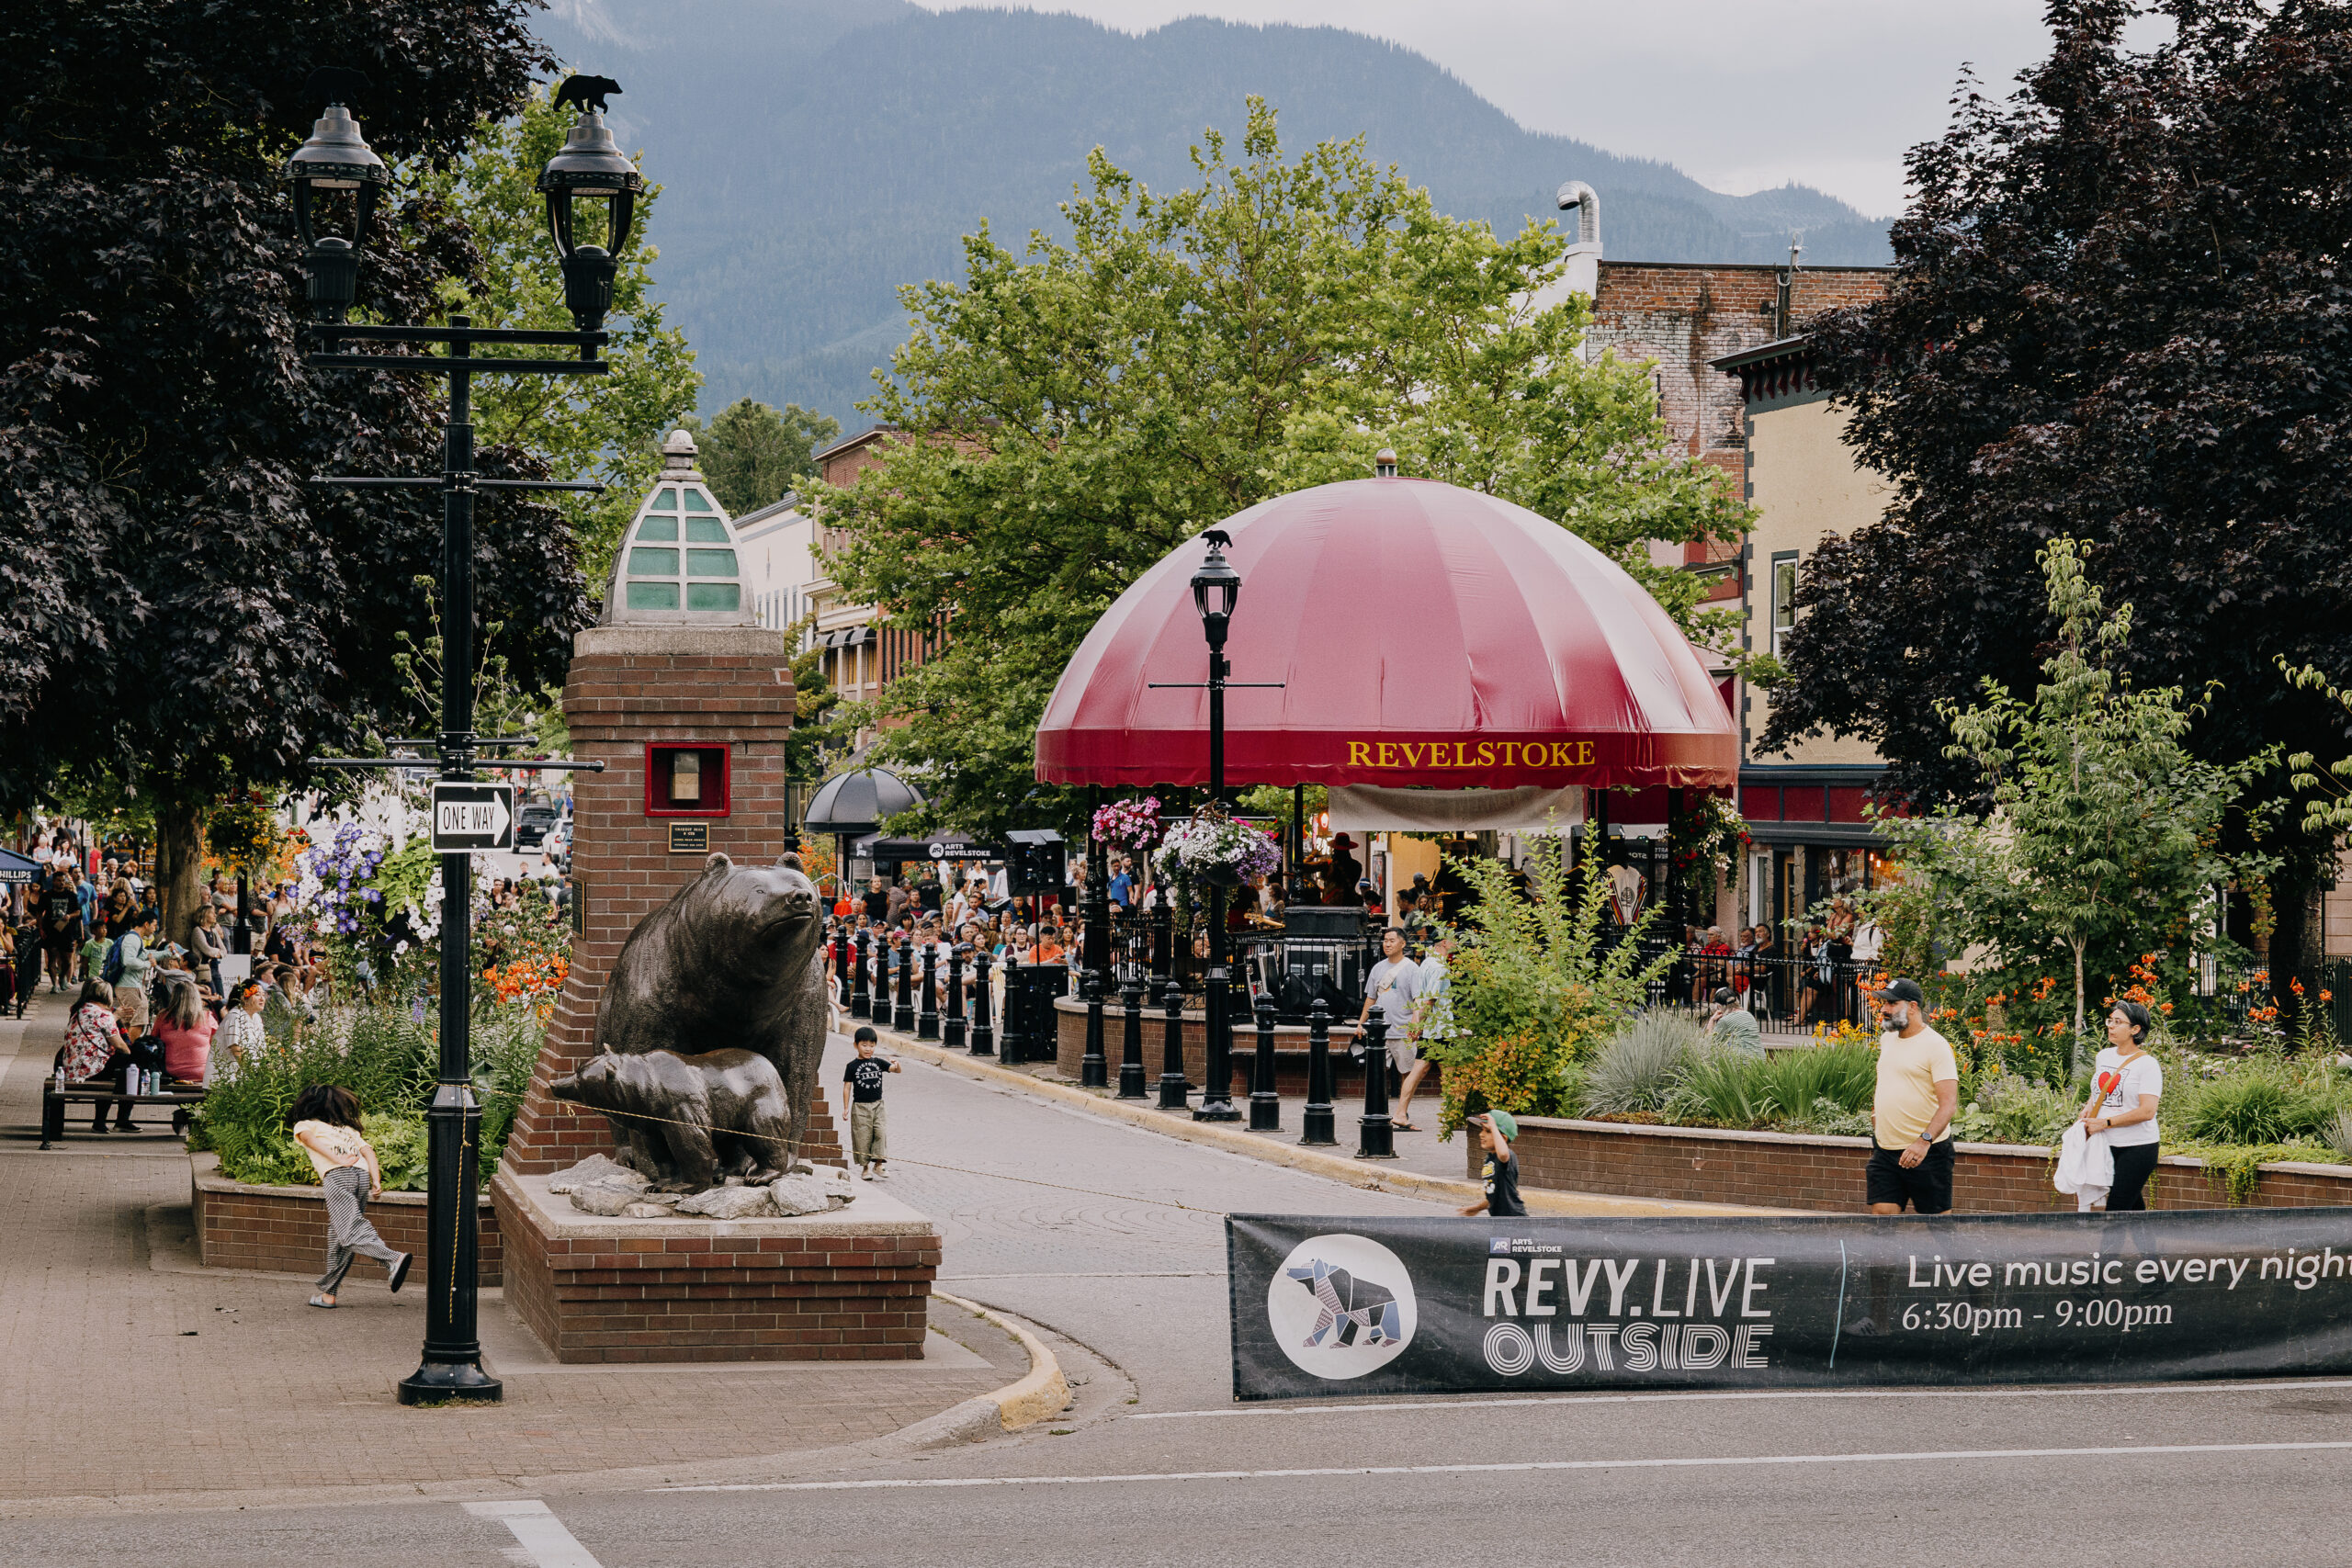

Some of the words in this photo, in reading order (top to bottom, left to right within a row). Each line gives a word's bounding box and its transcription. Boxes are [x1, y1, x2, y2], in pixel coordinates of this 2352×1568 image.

[1346, 740, 1596, 768] REVELSTOKE
[443, 806, 466, 829] ONE
[472, 806, 494, 829] WAY
[1483, 1258, 1776, 1317] REVY.LIVE
[1908, 1255, 1993, 1288] Live
[2005, 1252, 2123, 1286] music
[2135, 1257, 2251, 1290] every
[1902, 1302, 2023, 1337] 6:30pm
[2055, 1299, 2173, 1332] 9:00pm
[1483, 1322, 1775, 1377] OUTSIDE
